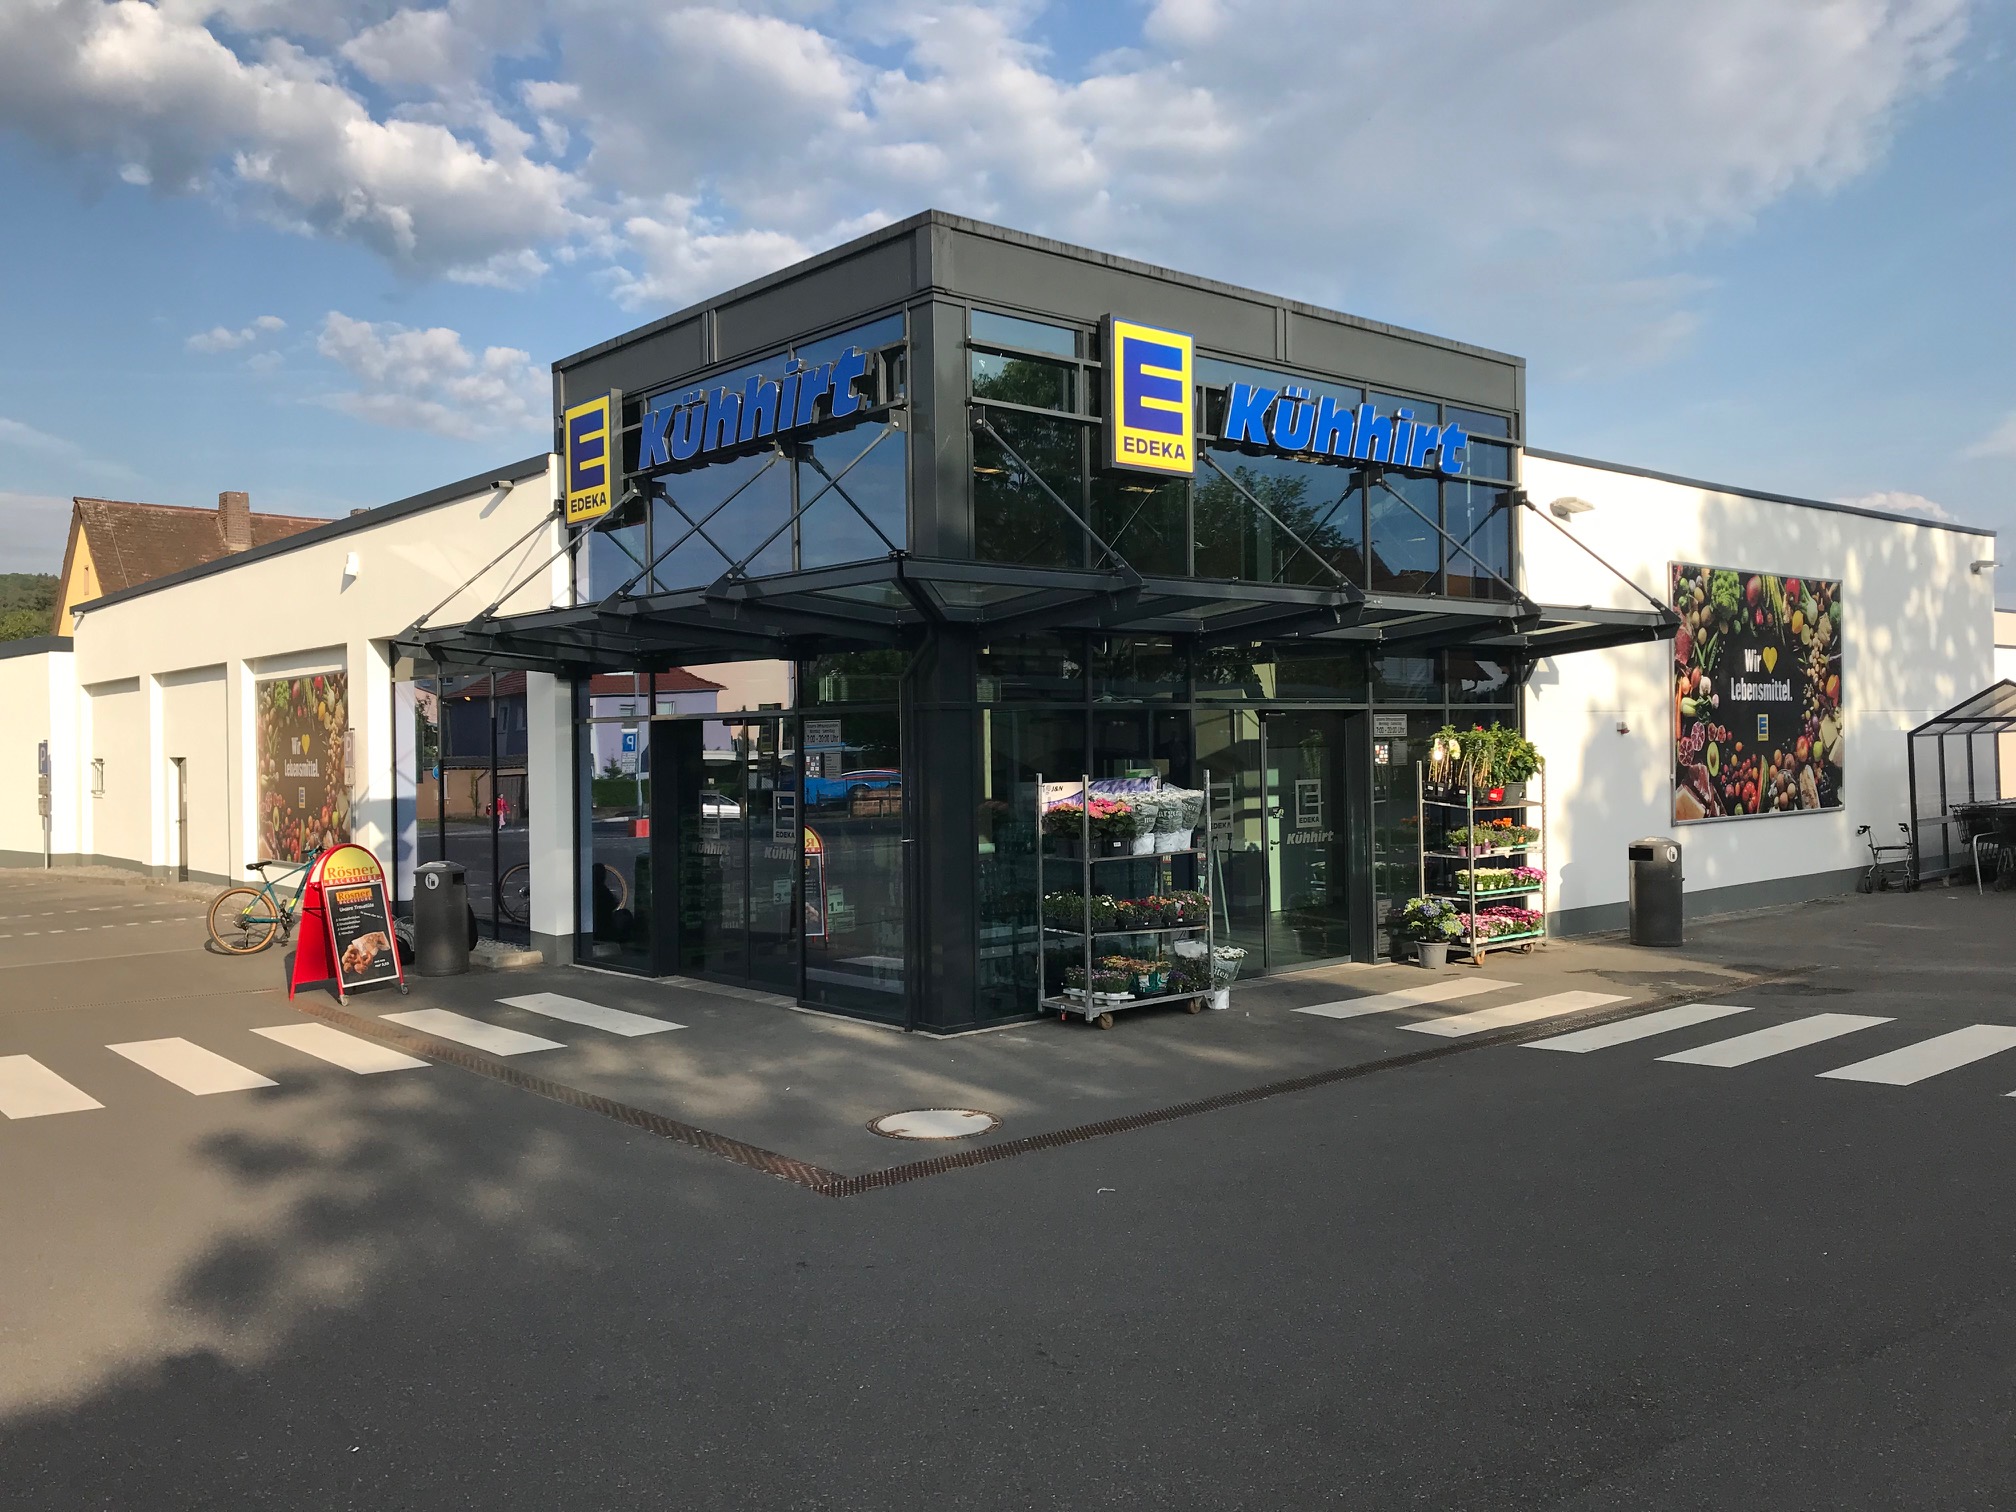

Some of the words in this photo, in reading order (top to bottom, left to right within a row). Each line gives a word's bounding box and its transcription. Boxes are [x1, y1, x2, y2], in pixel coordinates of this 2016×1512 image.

[638, 346, 867, 470] Kühhirt
[1222, 382, 1468, 474] Kühhirt
[1123, 435, 1186, 460] EDEKA
[571, 492, 607, 513] EDEKA
[1744, 648, 1762, 673] Wir
[1730, 677, 1793, 702] Lebensmittel.
[1210, 821, 1232, 830] EDEKA
[1299, 815, 1320, 824] EDEKA
[1286, 830, 1335, 845] Kühhirt
[764, 846, 797, 861] Kühhi
[327, 866, 375, 879] Rösner
[329, 874, 377, 885] BACKSTUBE
[337, 890, 370, 900] Rösner
